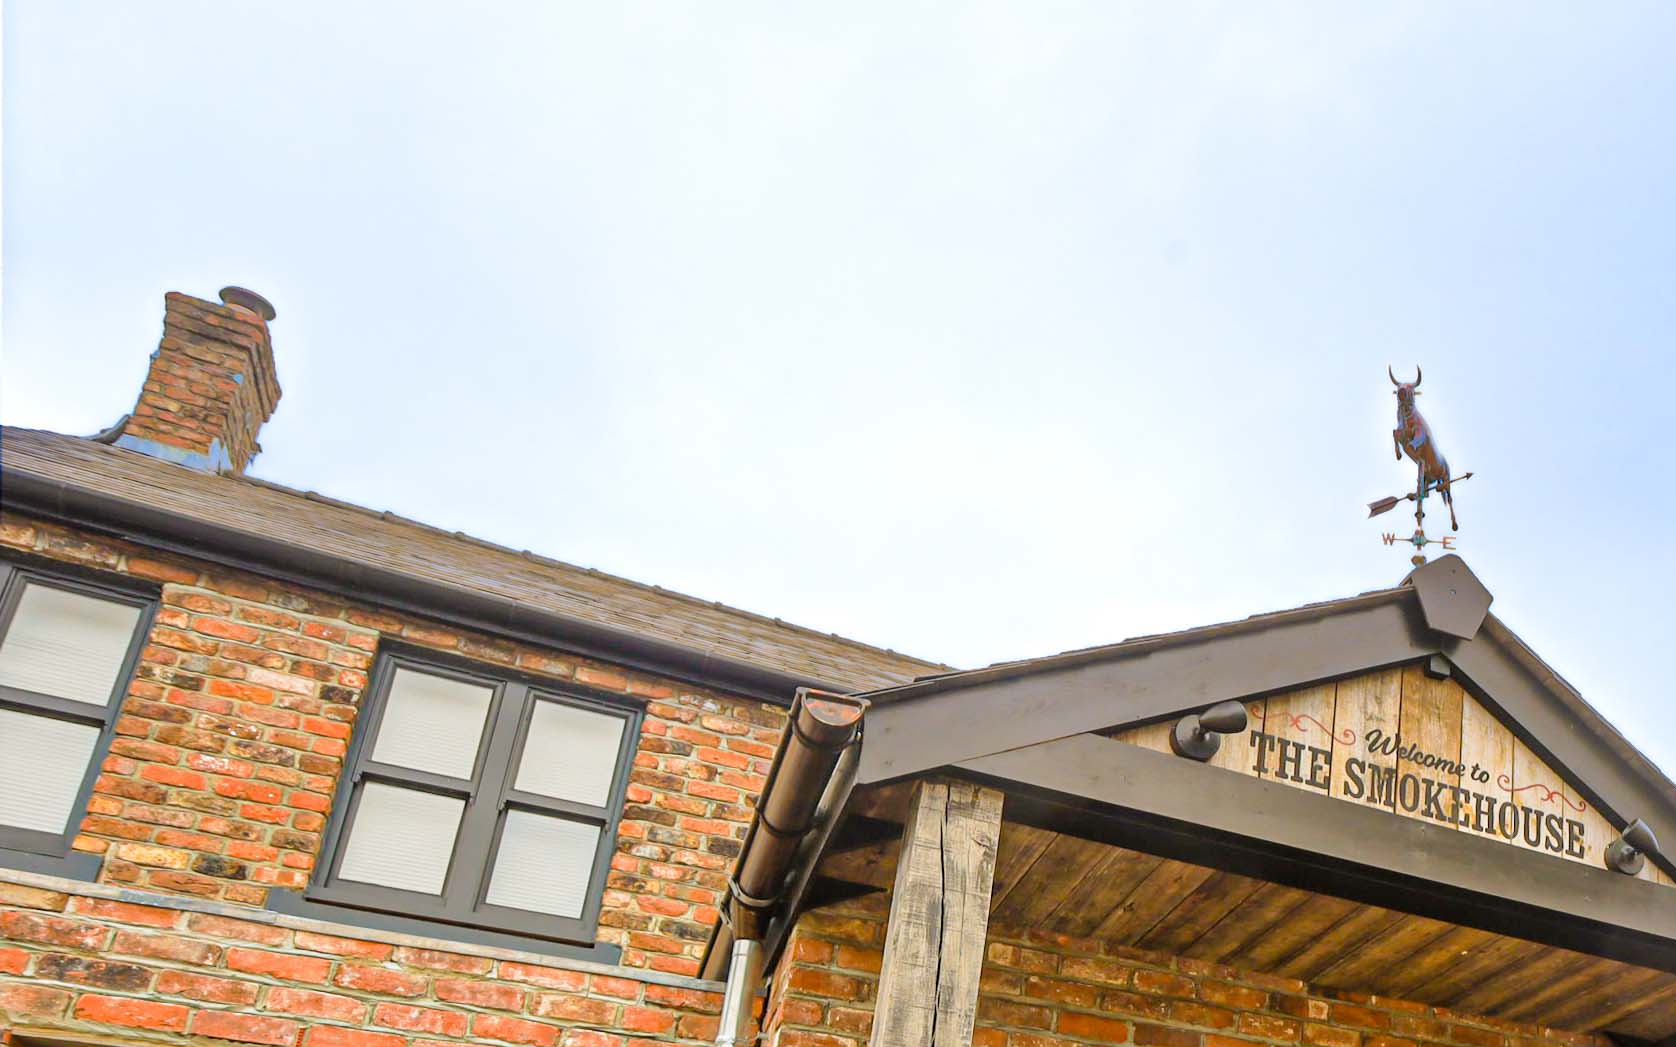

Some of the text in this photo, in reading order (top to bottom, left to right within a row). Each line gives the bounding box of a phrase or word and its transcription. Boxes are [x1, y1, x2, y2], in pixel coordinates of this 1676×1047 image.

[1382, 532, 1396, 546] W
[1442, 536, 1457, 550] E
[1365, 728, 1490, 784] Welcome to
[1250, 730, 1586, 859] THE SMOKEHOUSE
